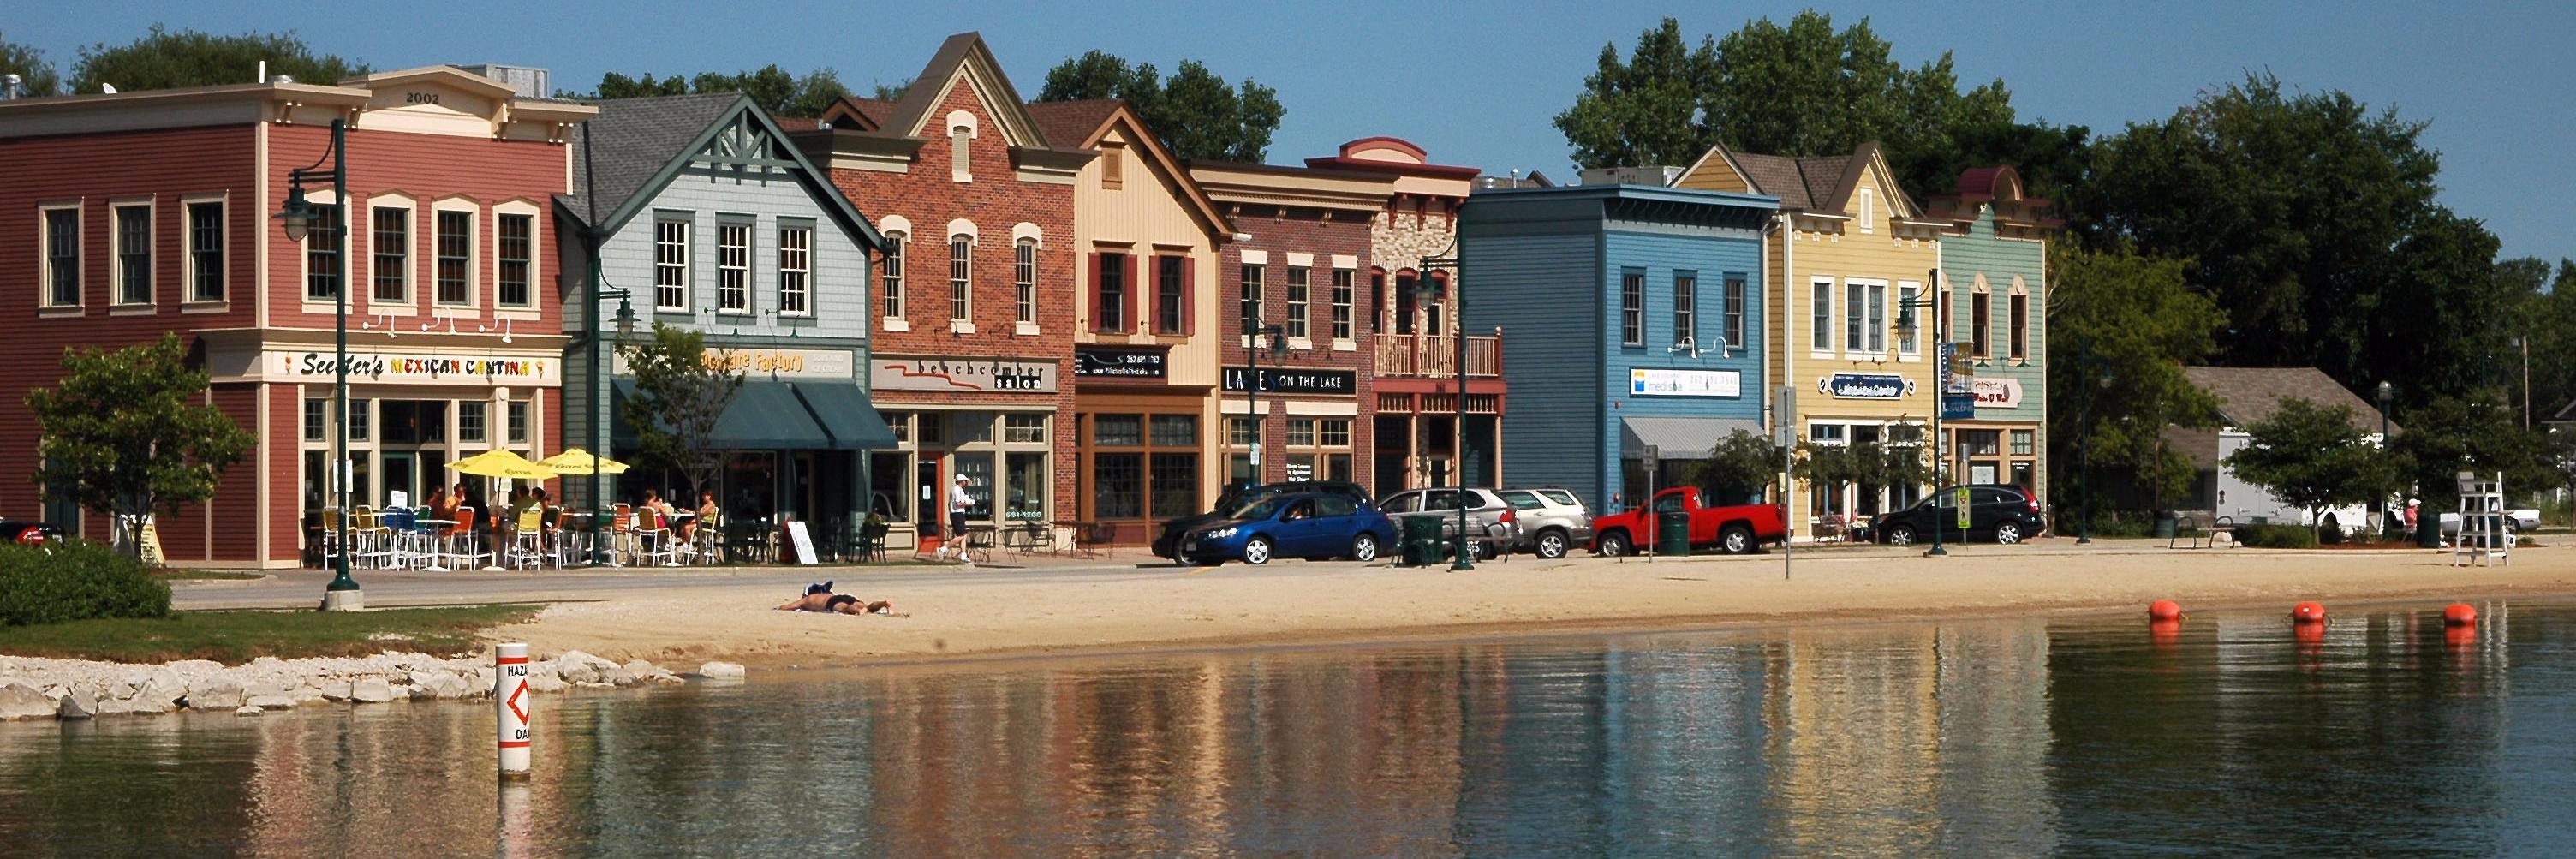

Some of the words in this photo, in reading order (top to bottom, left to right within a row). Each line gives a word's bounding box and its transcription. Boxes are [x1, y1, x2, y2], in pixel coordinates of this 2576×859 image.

[407, 92, 438, 104] 2002
[301, 353, 384, 375] Seeter's
[391, 358, 461, 374] MEXICAN
[466, 360, 530, 376] CANTINA
[755, 350, 803, 372] Factory
[918, 360, 1044, 377] beachcomber
[996, 375, 1041, 389] salon
[1279, 375, 1294, 386] ON
[1298, 375, 1315, 387] THE
[1320, 376, 1342, 388] LAKE
